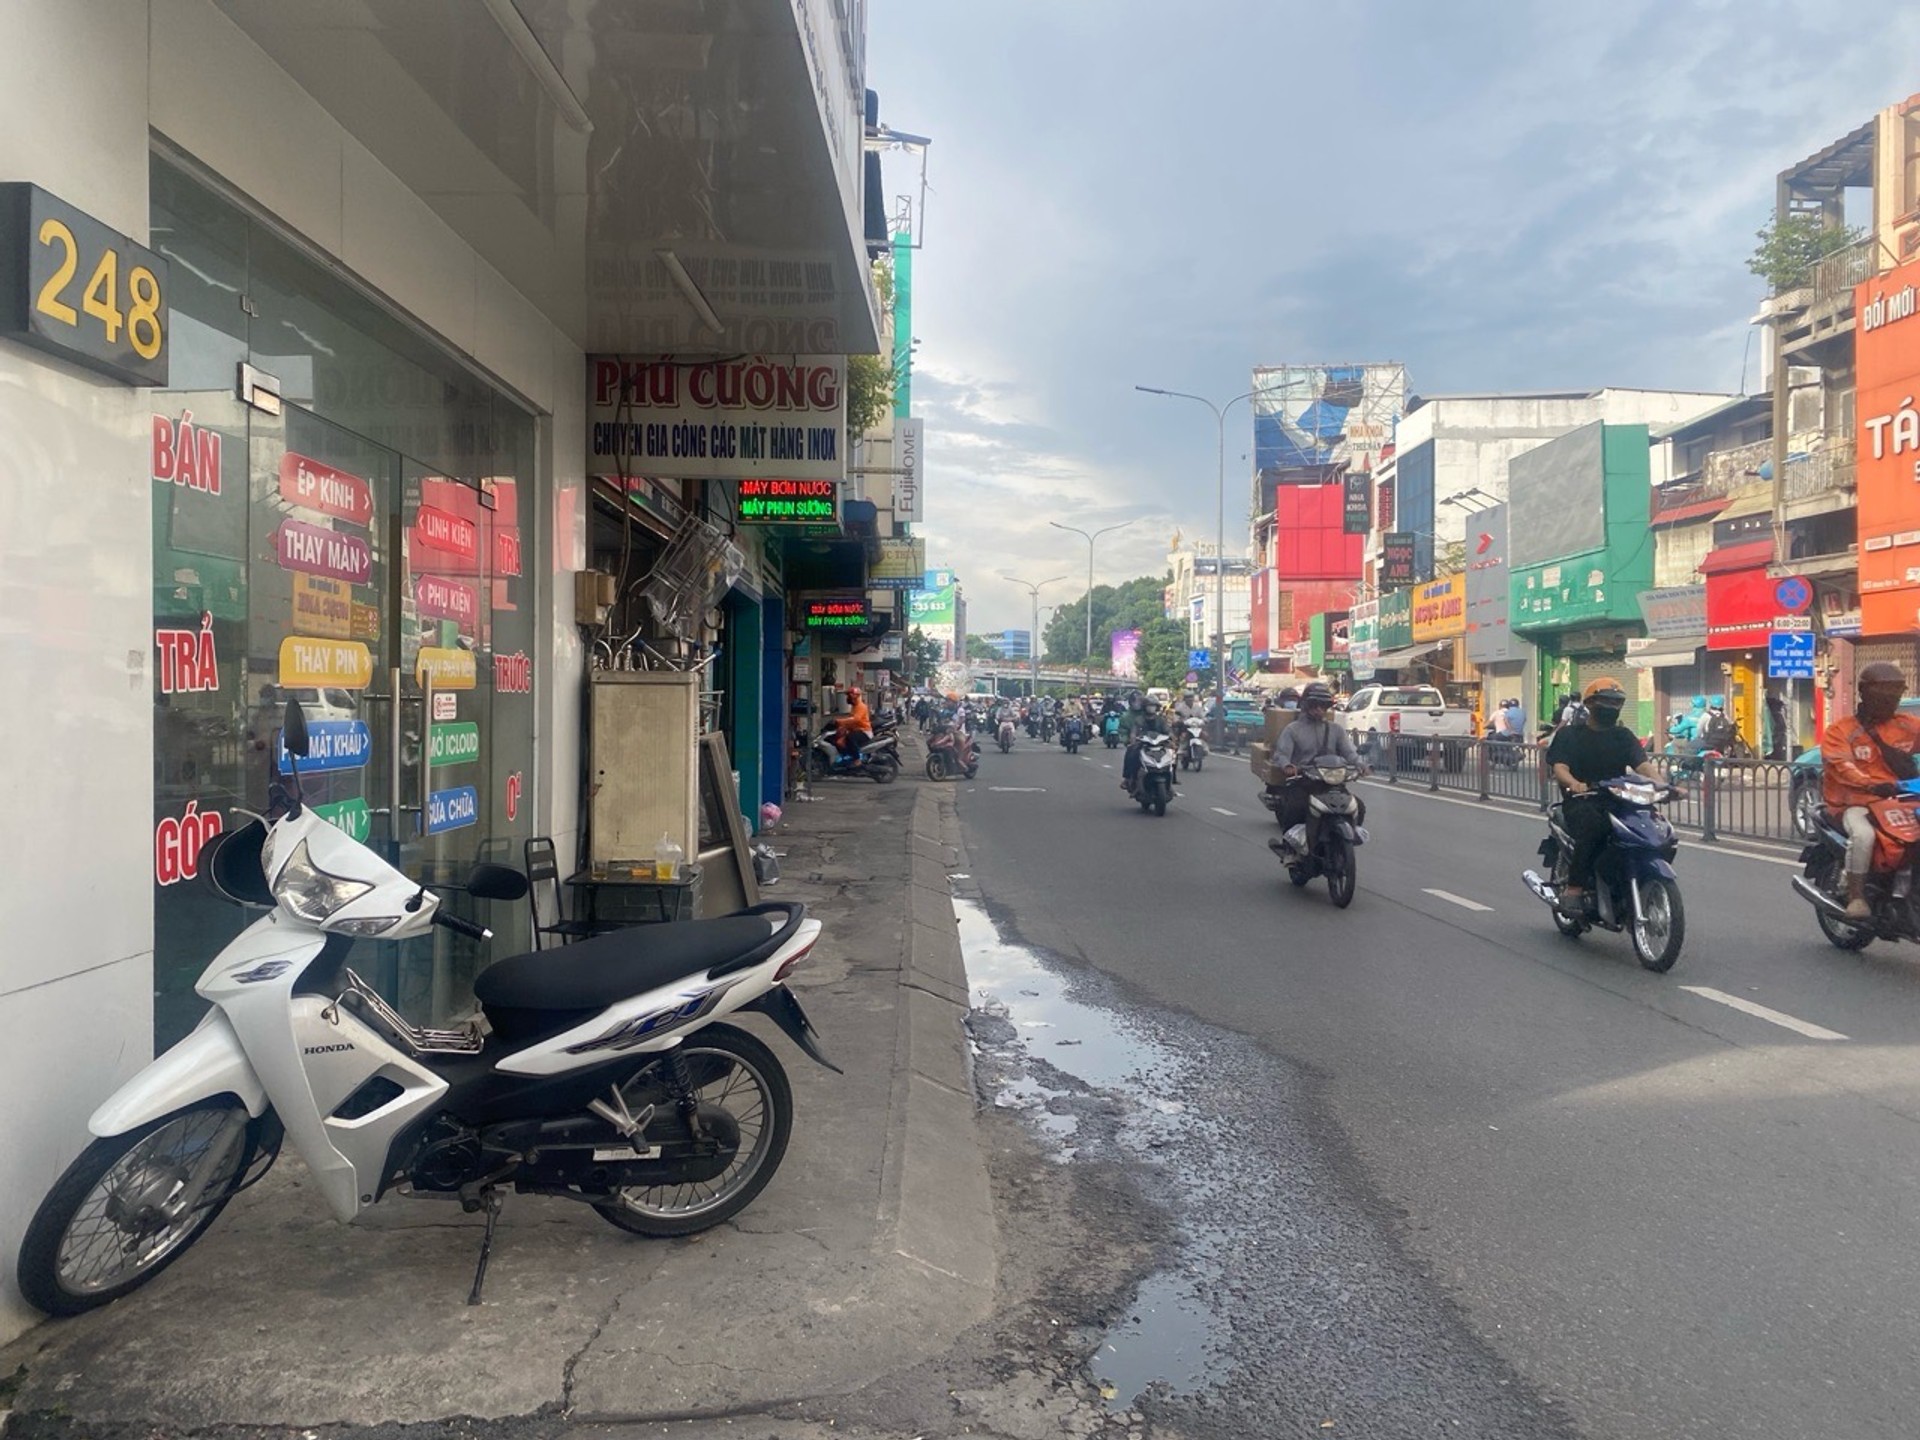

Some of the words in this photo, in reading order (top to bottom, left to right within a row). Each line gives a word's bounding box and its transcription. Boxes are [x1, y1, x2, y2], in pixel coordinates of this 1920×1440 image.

[36, 218, 162, 360] 248
[1864, 291, 1886, 333] ĐỔI
[1888, 284, 1917, 321] MỚI
[688, 355, 840, 411] CƯỜNG
[152, 409, 221, 496] BÁN
[646, 423, 668, 457] GIA
[711, 419, 736, 459] CÁC
[739, 422, 767, 465] MẶT
[770, 421, 804, 461] HÀNG
[807, 427, 837, 461] INOX
[297, 461, 316, 497] ÉP
[320, 473, 354, 511] KÍNH
[743, 480, 768, 495] MÁY
[771, 480, 796, 495] BƠM
[799, 480, 832, 495] NƯỚC
[743, 498, 765, 515] MÁY
[767, 500, 794, 515] PHUN
[284, 528, 323, 566] THAY
[328, 536, 360, 574] MÀN
[427, 514, 449, 541] LINH
[451, 520, 472, 552] KIỆN
[427, 583, 448, 614] PHỤ
[450, 586, 471, 618] KIỆN
[1415, 602, 1439, 626] NGỌC
[156, 610, 219, 693] TRẢ
[293, 645, 331, 673] THAY
[336, 648, 358, 674] PIN
[493, 650, 532, 694] TRƯỚC
[309, 728, 331, 765] MẬT
[334, 721, 361, 757] KHẨU
[445, 731, 478, 757] ICLOUD
[449, 791, 475, 820] CHỮA
[304, 1042, 356, 1055] HONDA
